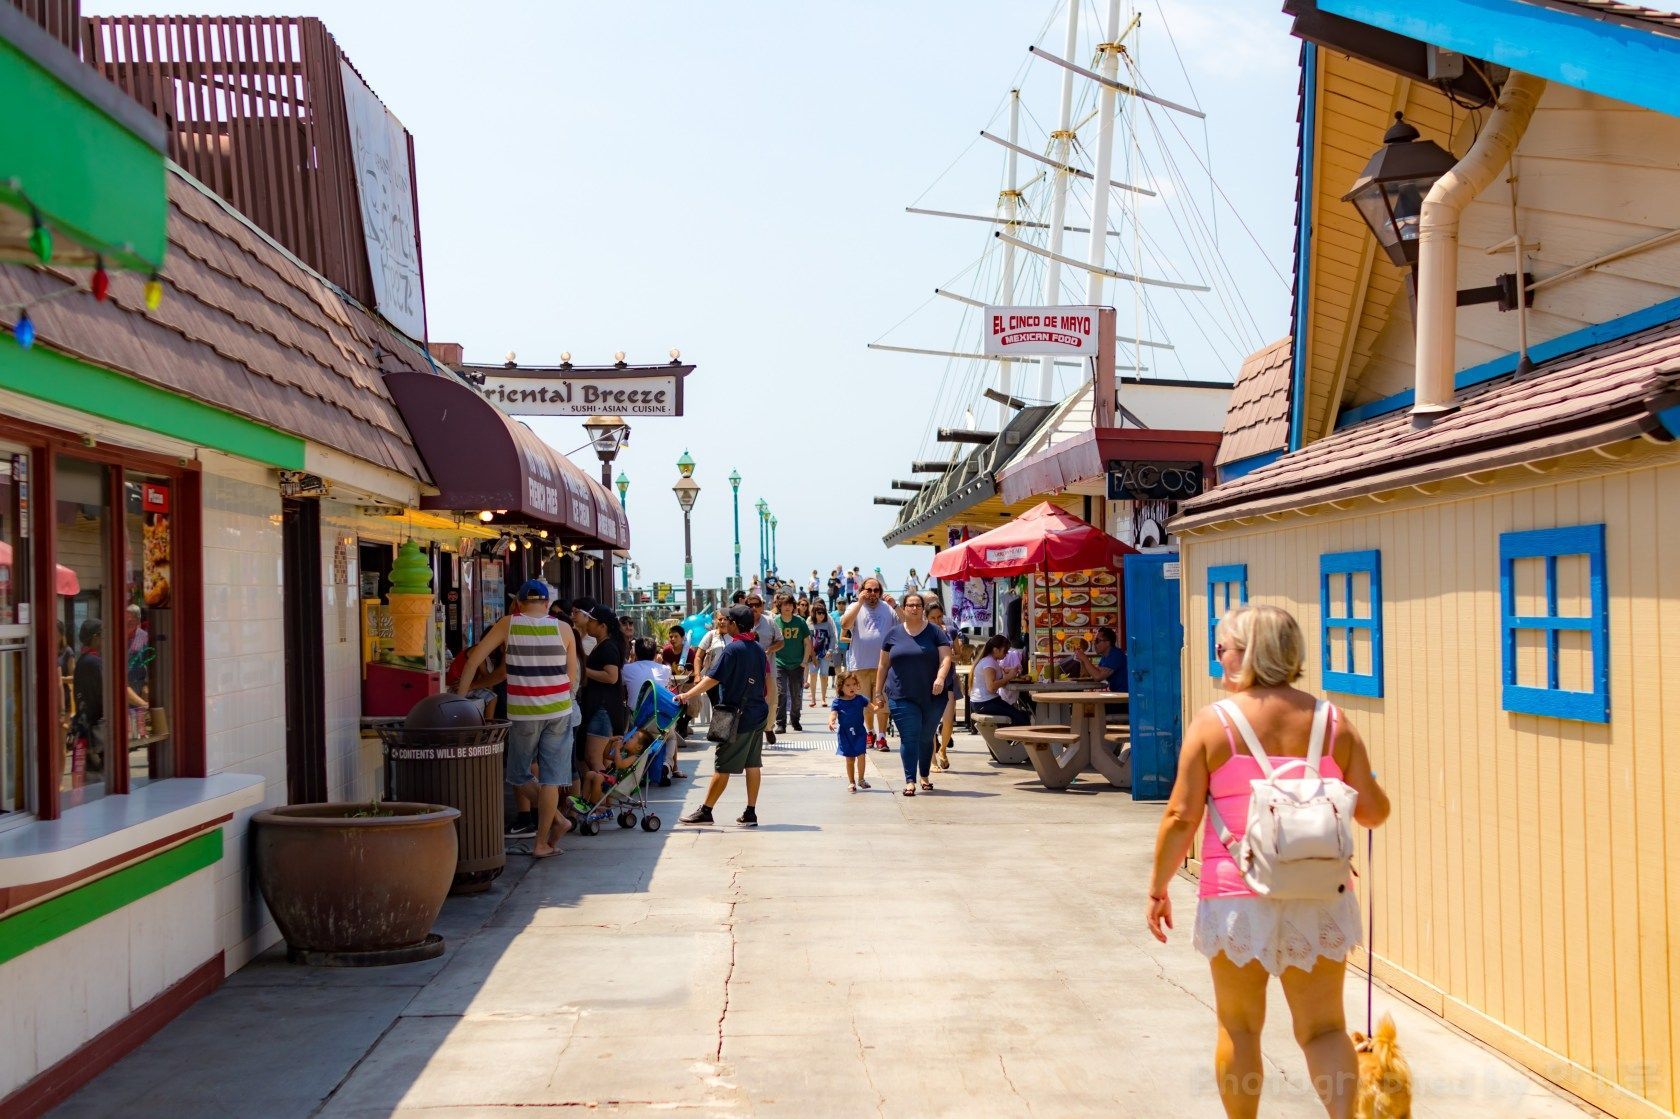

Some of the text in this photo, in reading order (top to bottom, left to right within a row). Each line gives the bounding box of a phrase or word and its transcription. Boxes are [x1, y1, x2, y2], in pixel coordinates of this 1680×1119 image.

[993, 315, 1091, 336] EL CINCO DE MAYO
[1005, 332, 1079, 346] MEXICAN FOOD
[581, 384, 666, 404] Breeze
[571, 405, 666, 413] SUSHI ASIAN CUISINE
[1109, 465, 1197, 495] TACOS
[399, 748, 435, 759] CONTENTS
[436, 748, 455, 759] WILL
[457, 747, 467, 758] BE
[468, 745, 492, 757] SORTED
